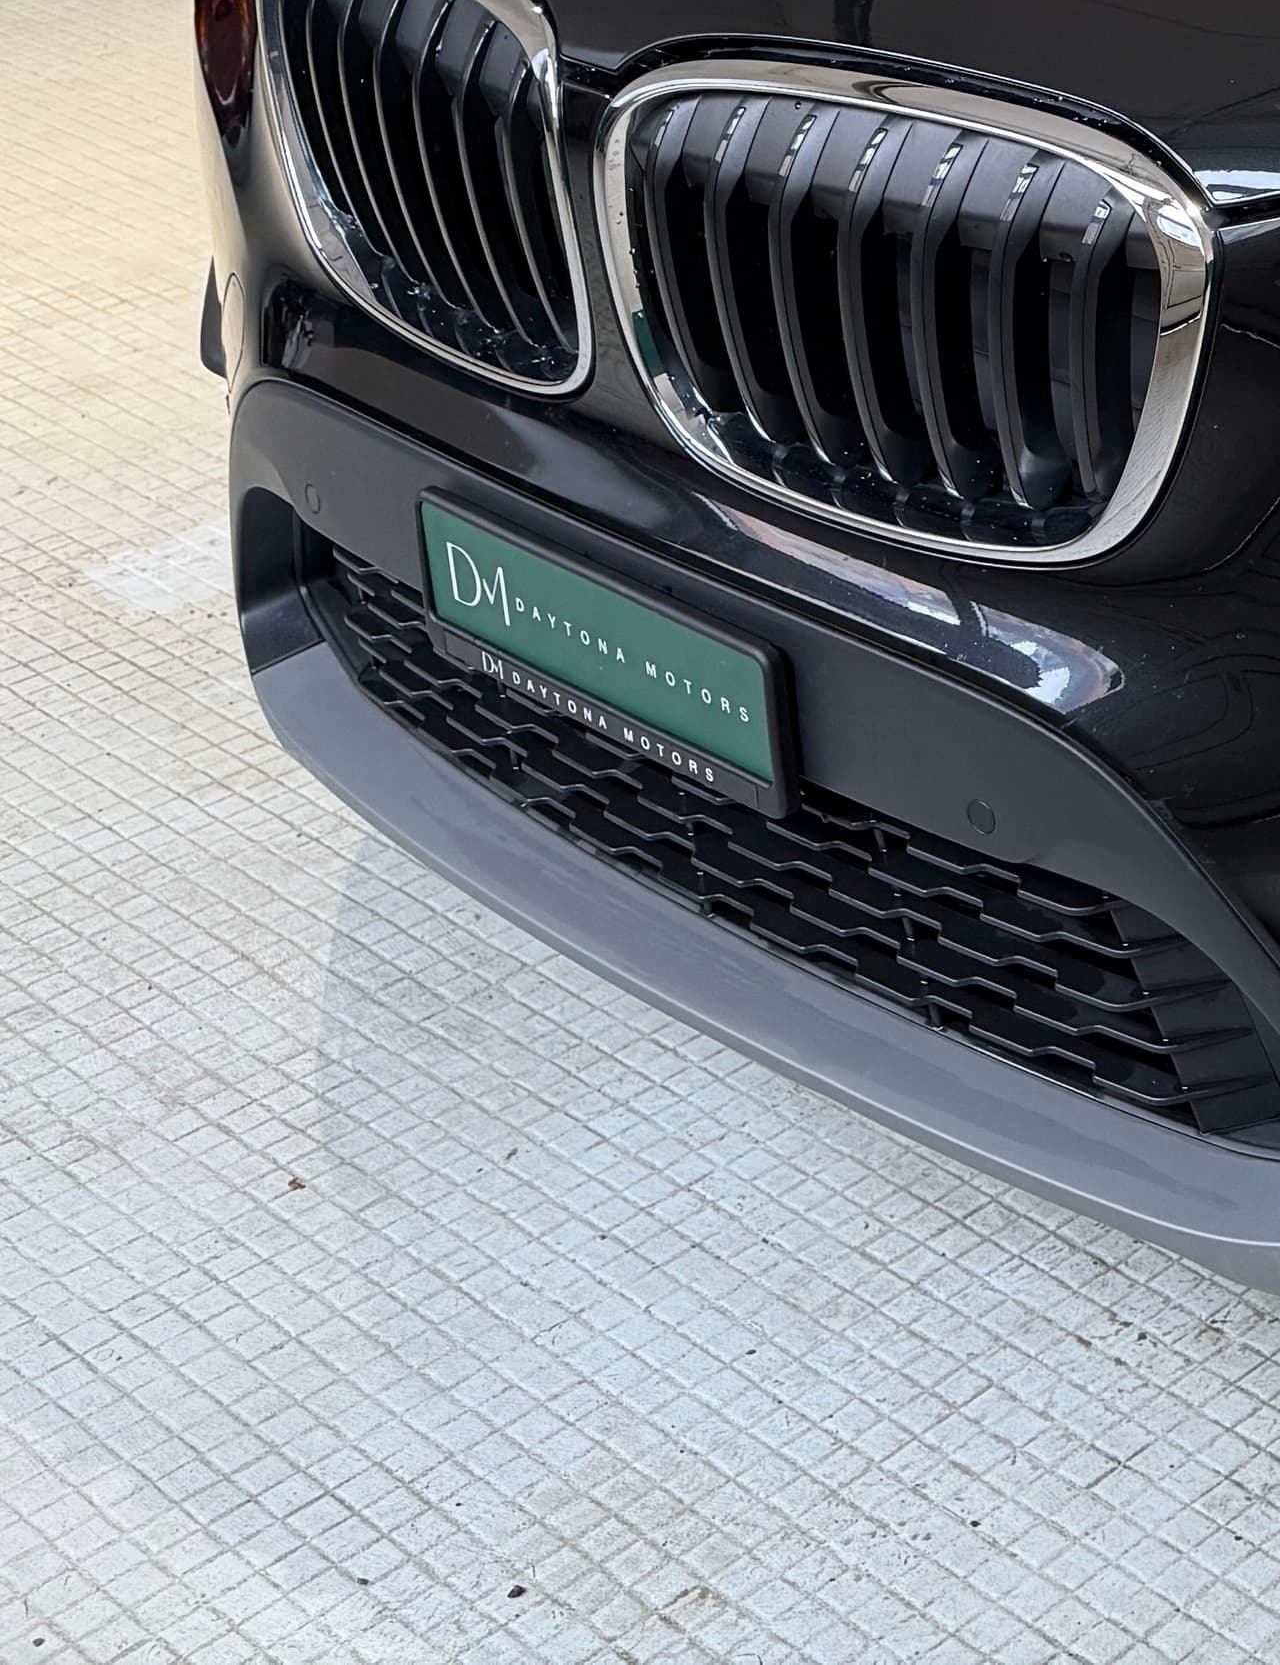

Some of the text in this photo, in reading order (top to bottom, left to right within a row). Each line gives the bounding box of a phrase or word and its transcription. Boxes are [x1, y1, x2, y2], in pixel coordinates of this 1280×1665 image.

[516, 597, 626, 664] DAYTONA
[645, 661, 750, 723] MOTORS
[512, 670, 607, 730] DAYTONA
[624, 729, 715, 783] MOTORS
